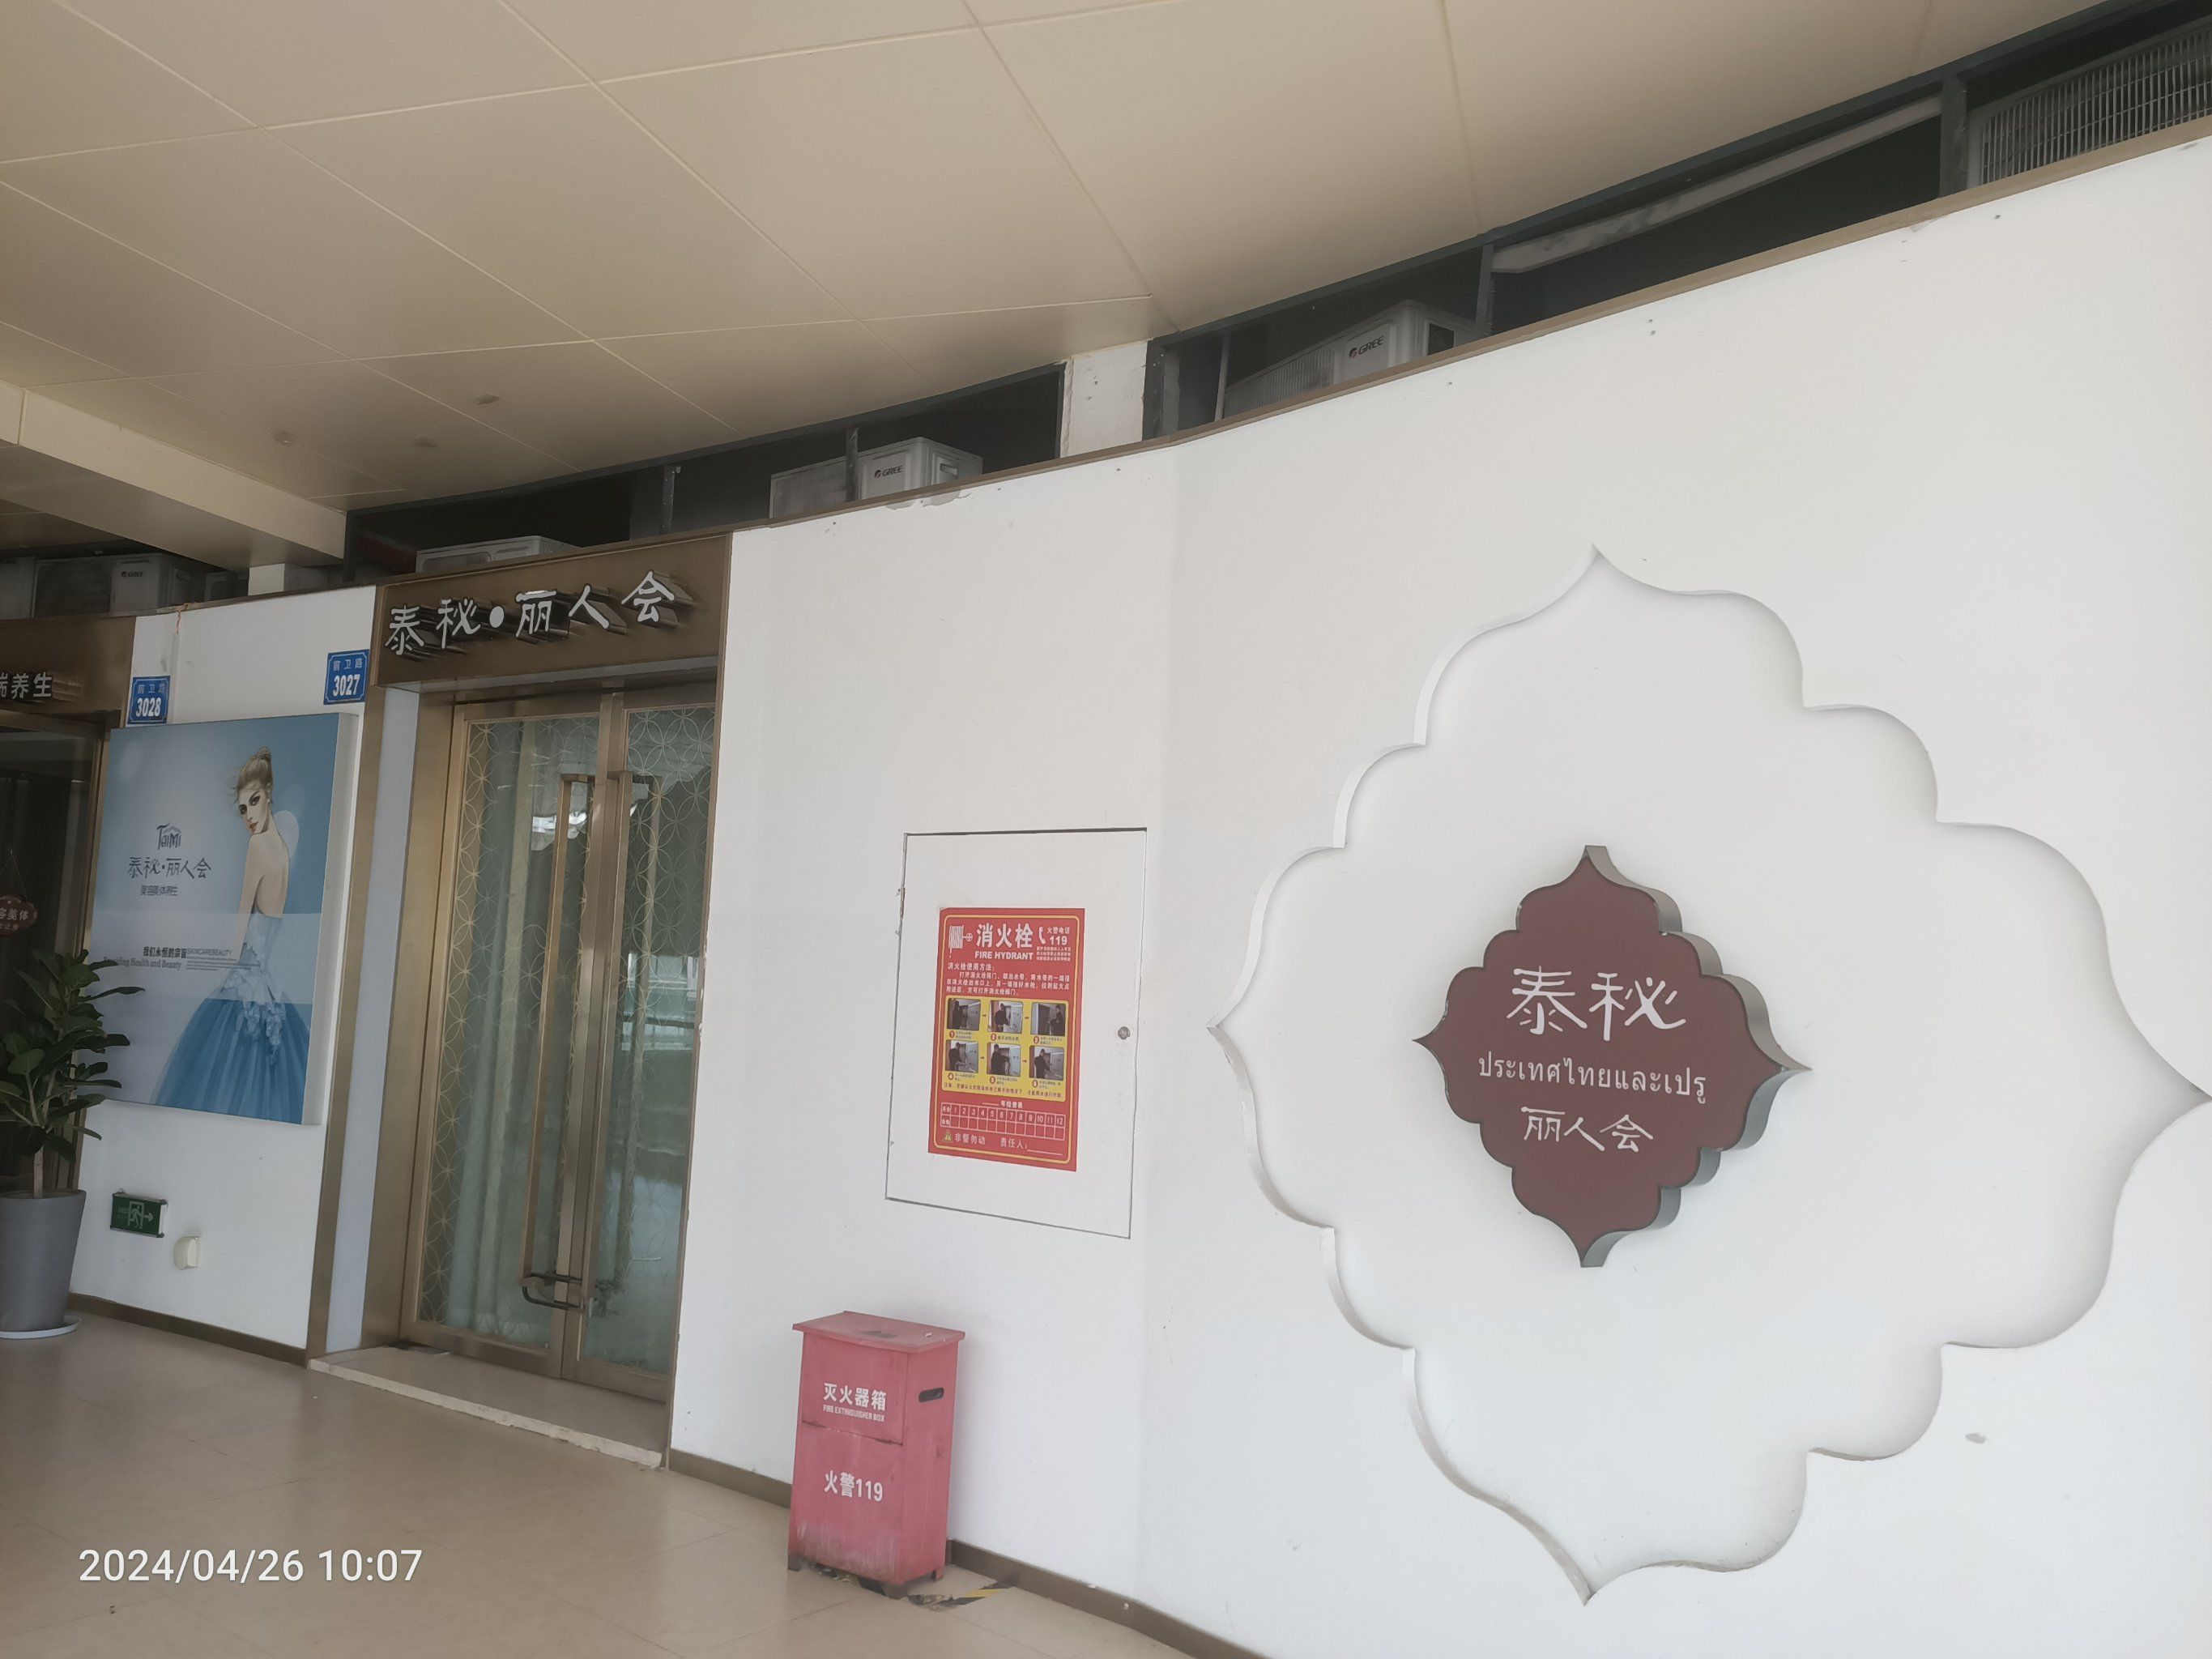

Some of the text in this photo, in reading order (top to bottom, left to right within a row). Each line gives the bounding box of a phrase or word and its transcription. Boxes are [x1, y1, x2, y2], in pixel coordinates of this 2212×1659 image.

[1358, 335, 1384, 355] GREE
[882, 465, 903, 476] GREE
[332, 673, 361, 697] 3027
[135, 697, 162, 717] 3028
[976, 923, 1034, 949] 消火栓
[1049, 935, 1068, 946] 119
[974, 950, 993, 960] FIRE
[994, 951, 1034, 961] HYDRANT
[1505, 965, 1686, 1042] 泰秘
[1477, 1051, 1707, 1104] ประเทศไทยและเปรู
[1037, 1115, 1043, 1123] 10
[1046, 1116, 1053, 1124] 11
[1056, 1117, 1063, 1125] 12
[1520, 1106, 1654, 1153] 丽人会
[954, 1132, 986, 1145] 非警勿动
[823, 1382, 887, 1411] 灭火器箱
[824, 1469, 884, 1502] 火警119
